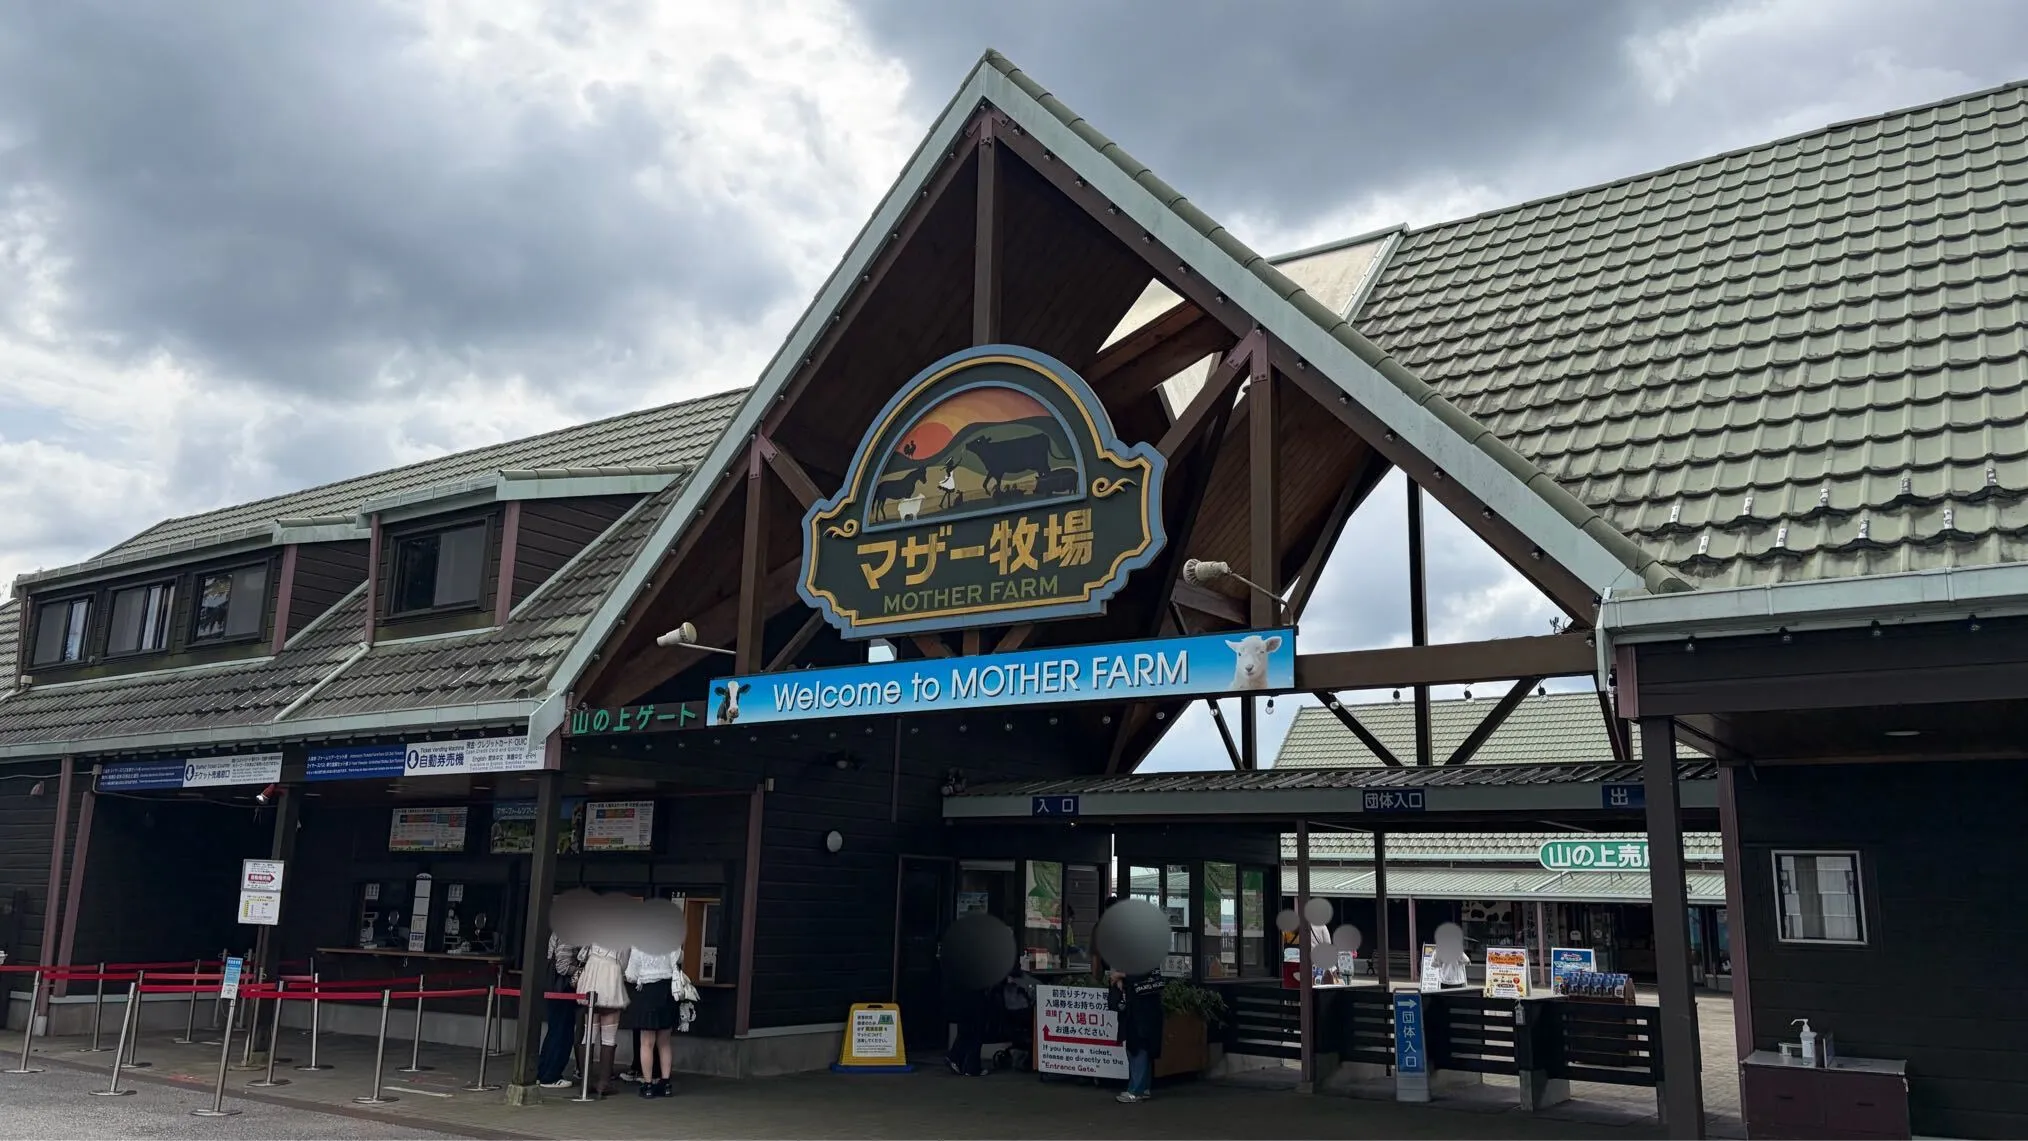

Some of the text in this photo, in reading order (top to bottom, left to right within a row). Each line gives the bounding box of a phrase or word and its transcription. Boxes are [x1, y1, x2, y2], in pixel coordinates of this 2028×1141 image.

[857, 507, 1093, 590] マザー牧場
[883, 575, 1058, 614] MOTHER FARM
[773, 650, 1188, 712] Welcome to MOTHER FARM
[572, 702, 696, 735] 山の上ゲート
[419, 753, 465, 769] 自動券売機
[1036, 798, 1074, 813] 入口
[1365, 792, 1422, 808] 団体入口
[1050, 1045, 1061, 1053] you
[1402, 1011, 1417, 1067] 団体入口
[1075, 1054, 1100, 1065] directly
[1103, 1056, 1110, 1064] to
